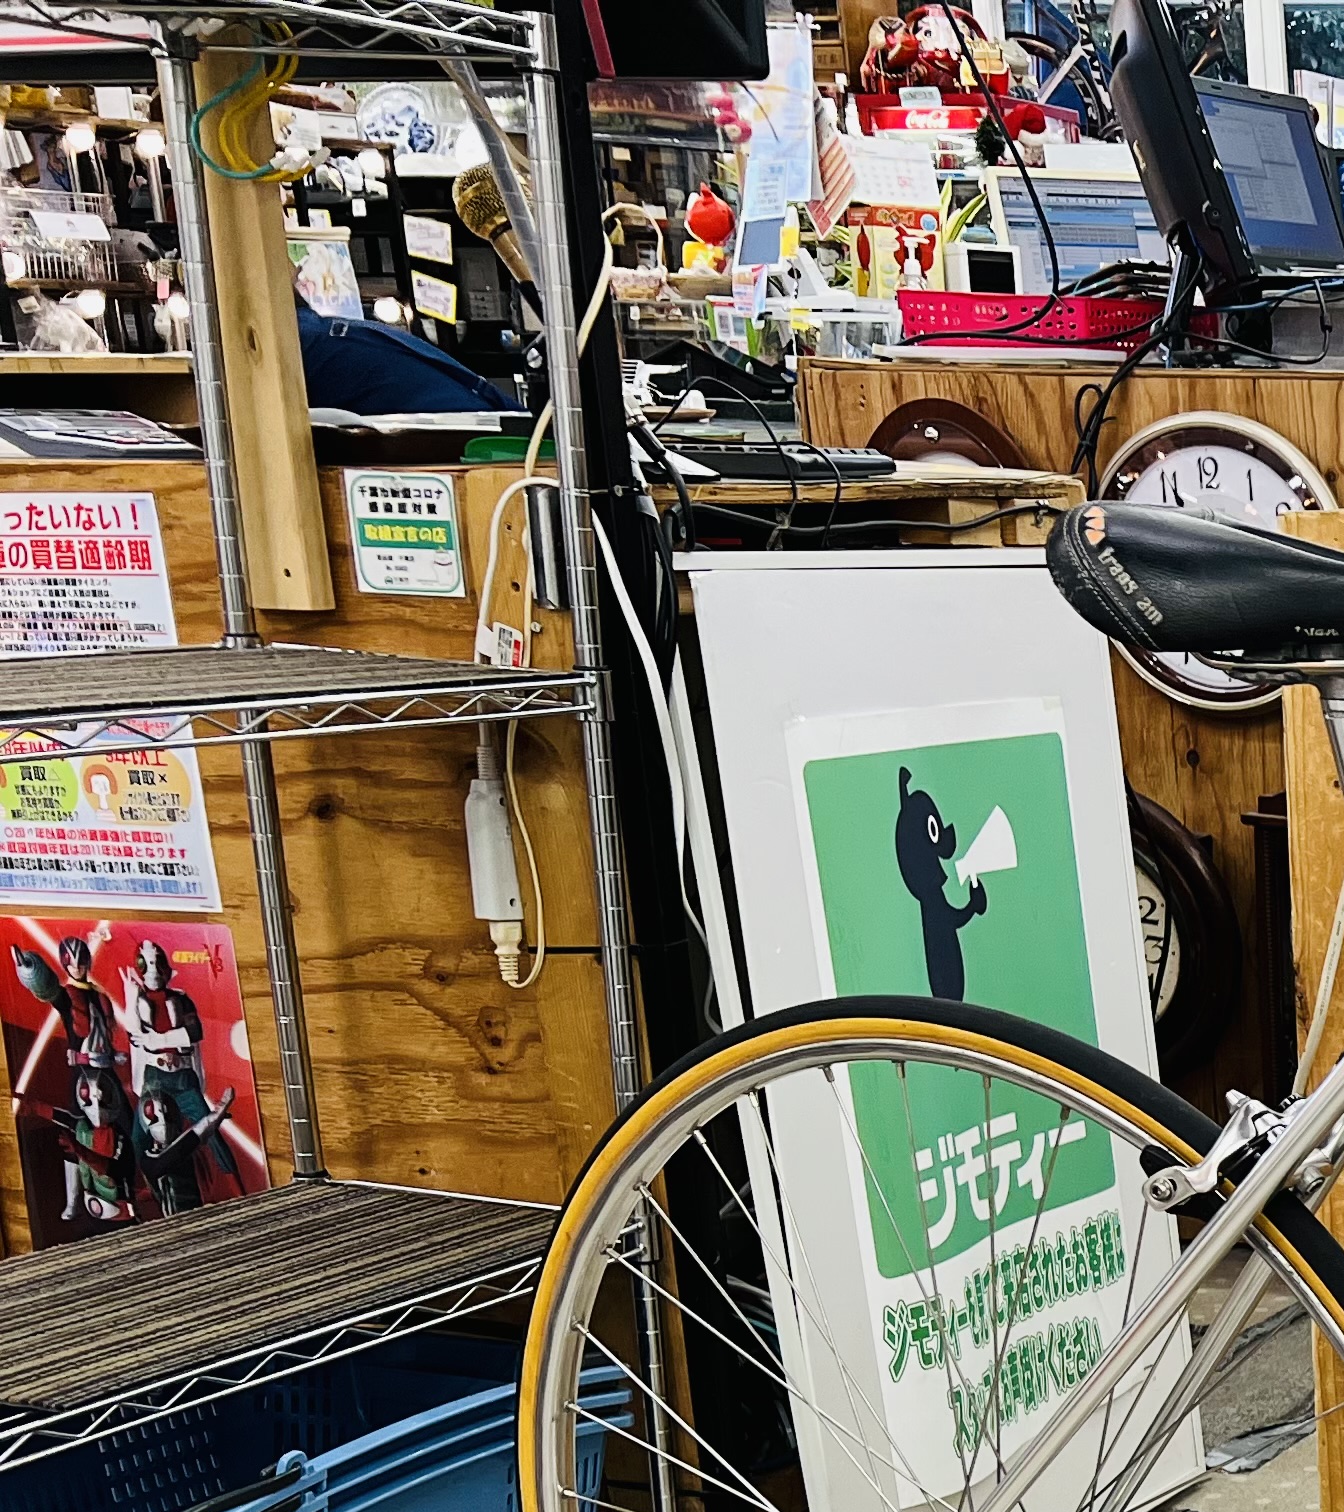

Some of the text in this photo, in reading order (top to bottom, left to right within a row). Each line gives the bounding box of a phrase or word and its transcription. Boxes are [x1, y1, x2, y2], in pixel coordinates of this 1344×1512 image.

[1198, 456, 1219, 489] 12
[4, 502, 139, 531] ったいない!
[0, 540, 152, 570] の買替適齢期
[914, 1112, 1087, 1249] ジモティー
